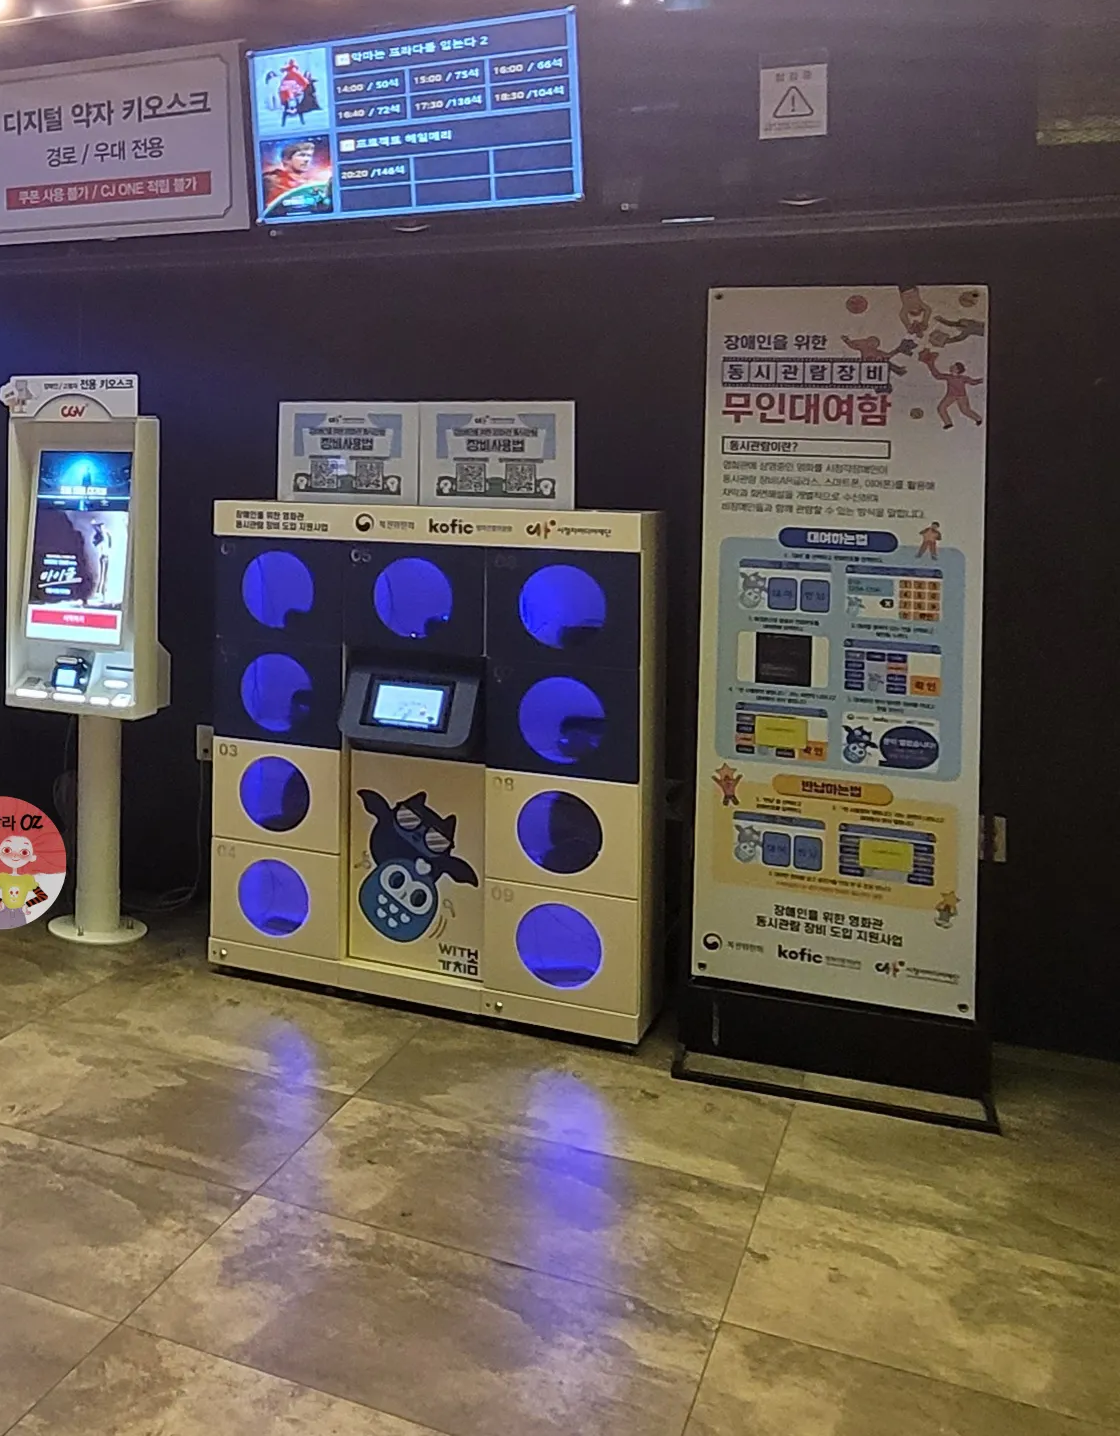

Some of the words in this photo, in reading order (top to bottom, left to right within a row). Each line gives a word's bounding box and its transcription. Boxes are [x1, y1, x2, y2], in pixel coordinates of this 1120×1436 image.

[480, 35, 489, 46] 2
[3, 105, 63, 136] 디지털
[71, 99, 115, 129] 약자
[122, 90, 212, 123] 키오스크
[46, 145, 78, 168] 경로
[94, 139, 126, 163] 우대
[131, 135, 165, 159] 전용
[18, 190, 41, 205] 쿠폰
[42, 187, 64, 204] 사용
[100, 183, 116, 199] CJ
[119, 180, 145, 197] ONE
[723, 333, 789, 351] 장애인을
[793, 334, 828, 351] 위한
[99, 378, 134, 390] 키오스크
[60, 405, 87, 418] CGV
[721, 392, 892, 426] 무인대여함
[428, 518, 475, 535] kofic
[218, 744, 239, 758] 03
[822, 910, 846, 925] 위한
[848, 913, 884, 932] 영화관
[803, 921, 827, 937] 장비
[830, 925, 853, 940] 도입
[856, 928, 904, 948] 지원사업
[438, 942, 478, 960] WITH
[777, 944, 824, 965] kofic
